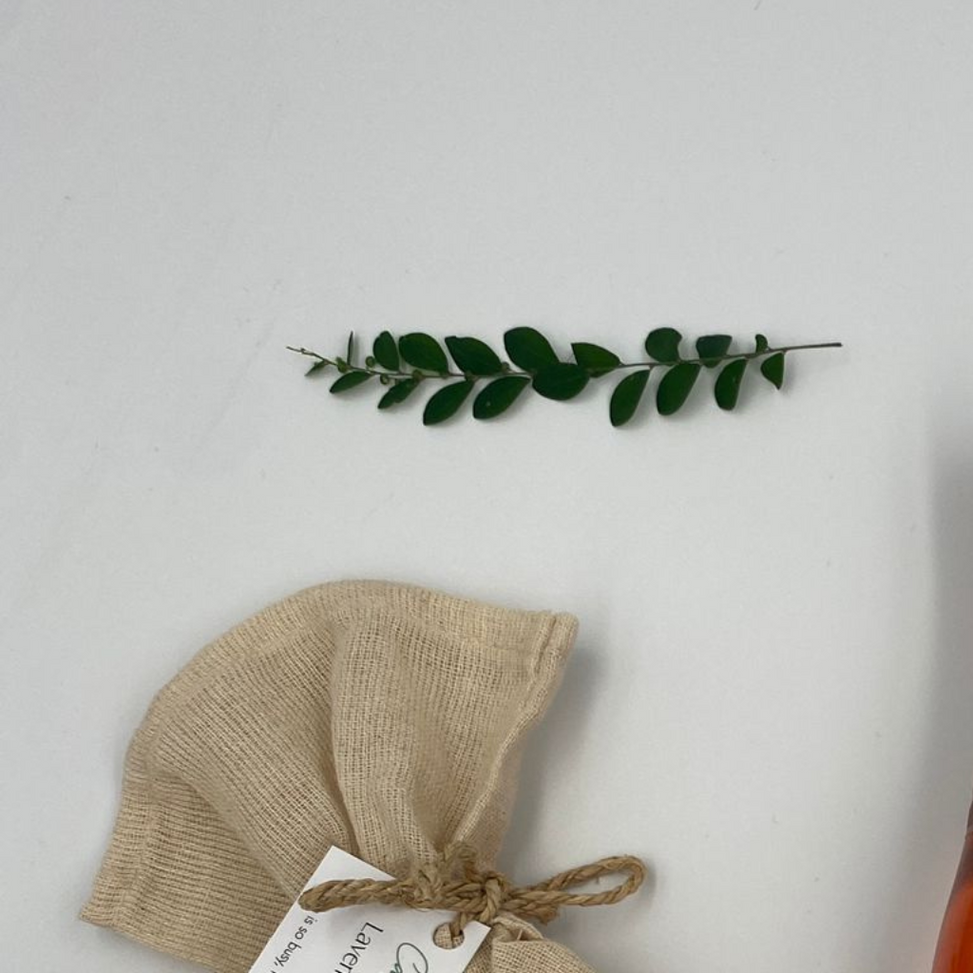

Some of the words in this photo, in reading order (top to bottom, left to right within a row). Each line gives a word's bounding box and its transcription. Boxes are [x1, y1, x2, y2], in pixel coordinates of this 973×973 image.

[304, 915, 318, 925] is
[294, 926, 308, 940] so
[273, 941, 302, 967] busy,
